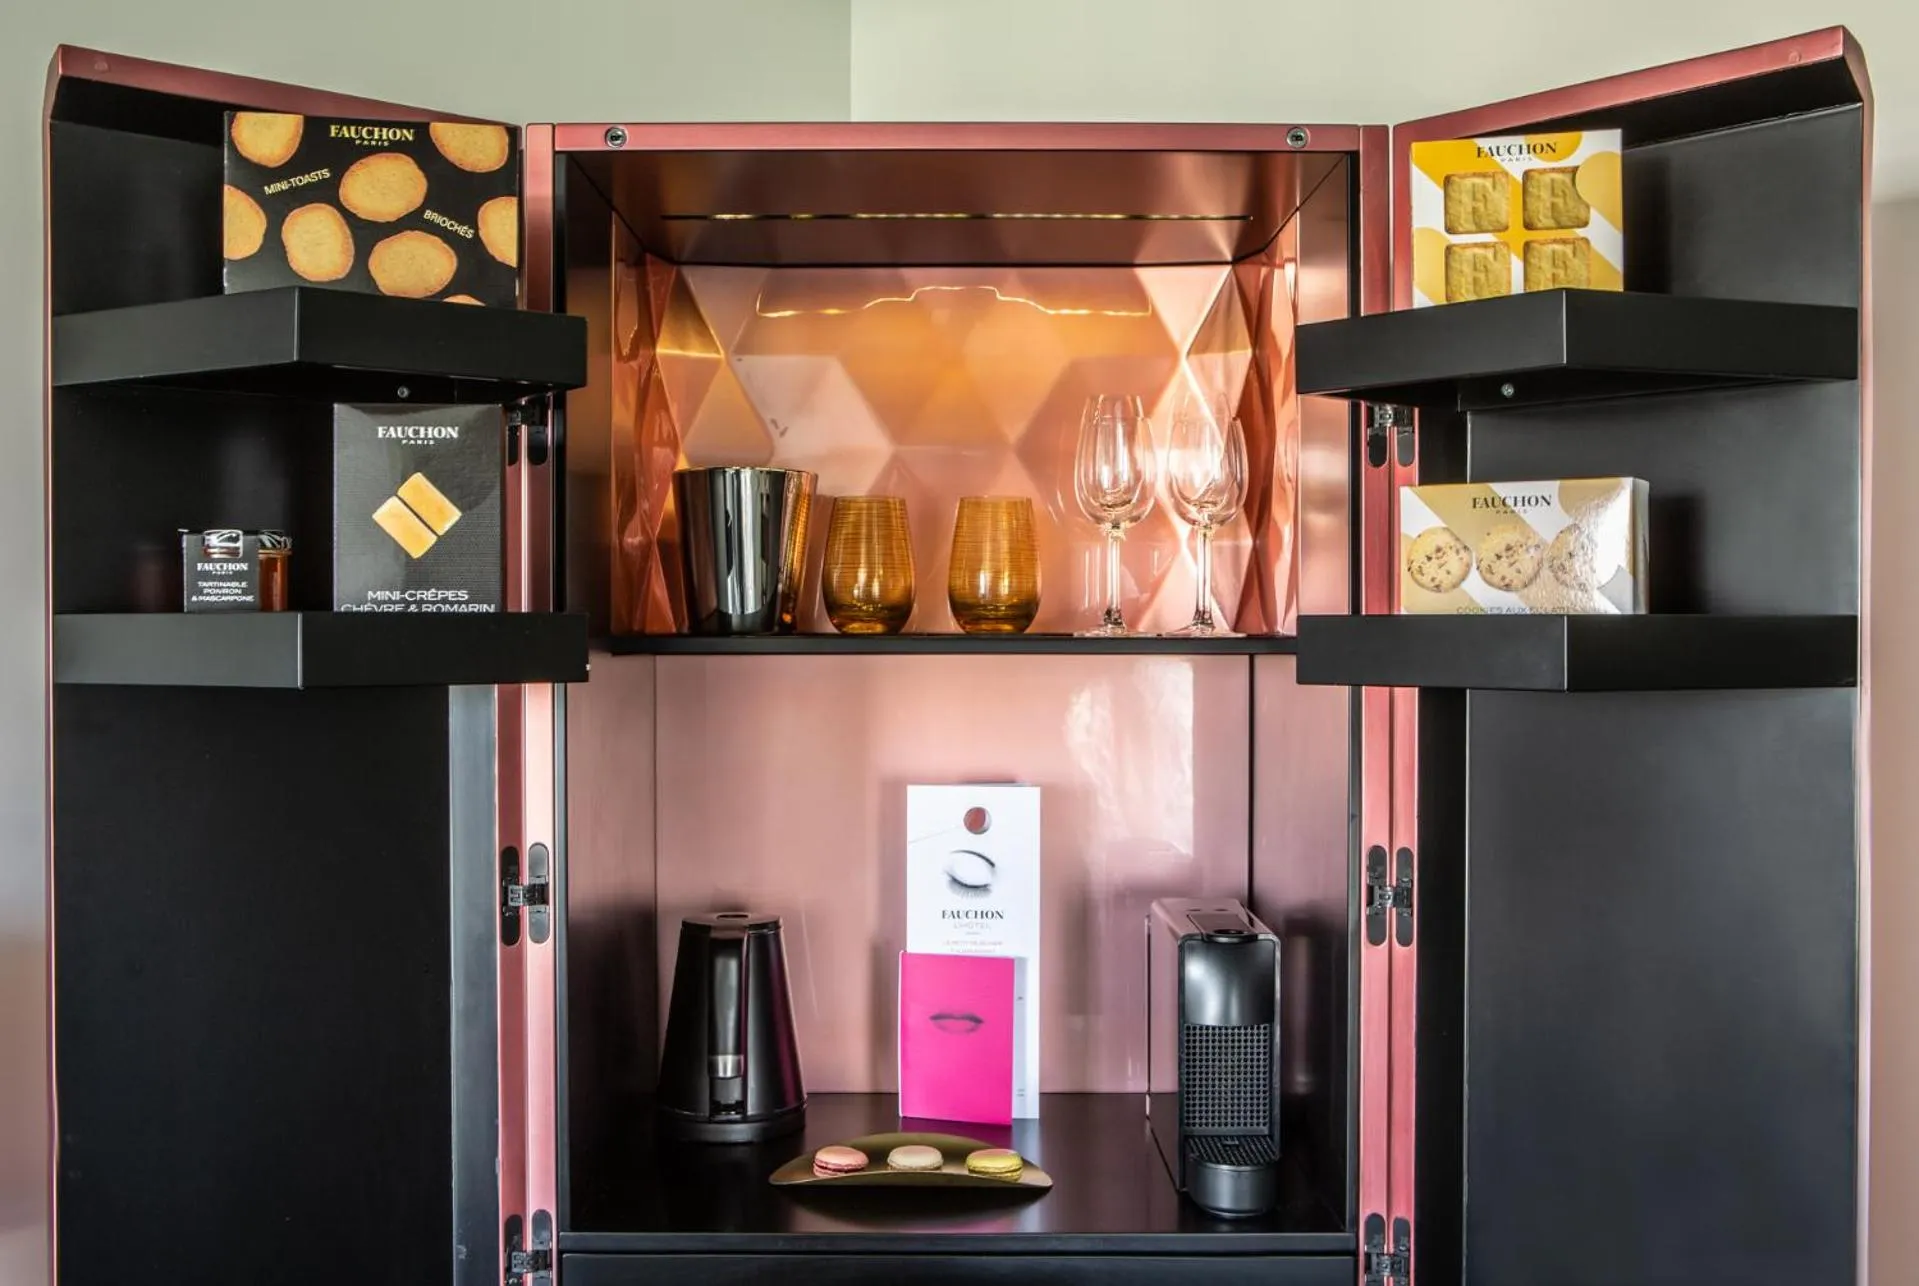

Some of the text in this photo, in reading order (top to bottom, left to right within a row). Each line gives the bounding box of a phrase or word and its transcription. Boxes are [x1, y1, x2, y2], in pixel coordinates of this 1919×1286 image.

[328, 124, 415, 141] FAUCHON
[355, 139, 389, 147] PARIS
[1476, 142, 1557, 158] FAUCHON
[264, 168, 331, 195] MINI-TOASTS
[423, 209, 475, 239] BRIOCHÉS
[377, 425, 459, 439] FAUCHON
[1472, 494, 1552, 509] FAUCHON
[196, 562, 249, 571] FAUCHON
[367, 588, 469, 601] MINI-CRÊPES
[421, 603, 496, 612] ROMARIN
[941, 910, 1004, 920] FAUCHON
